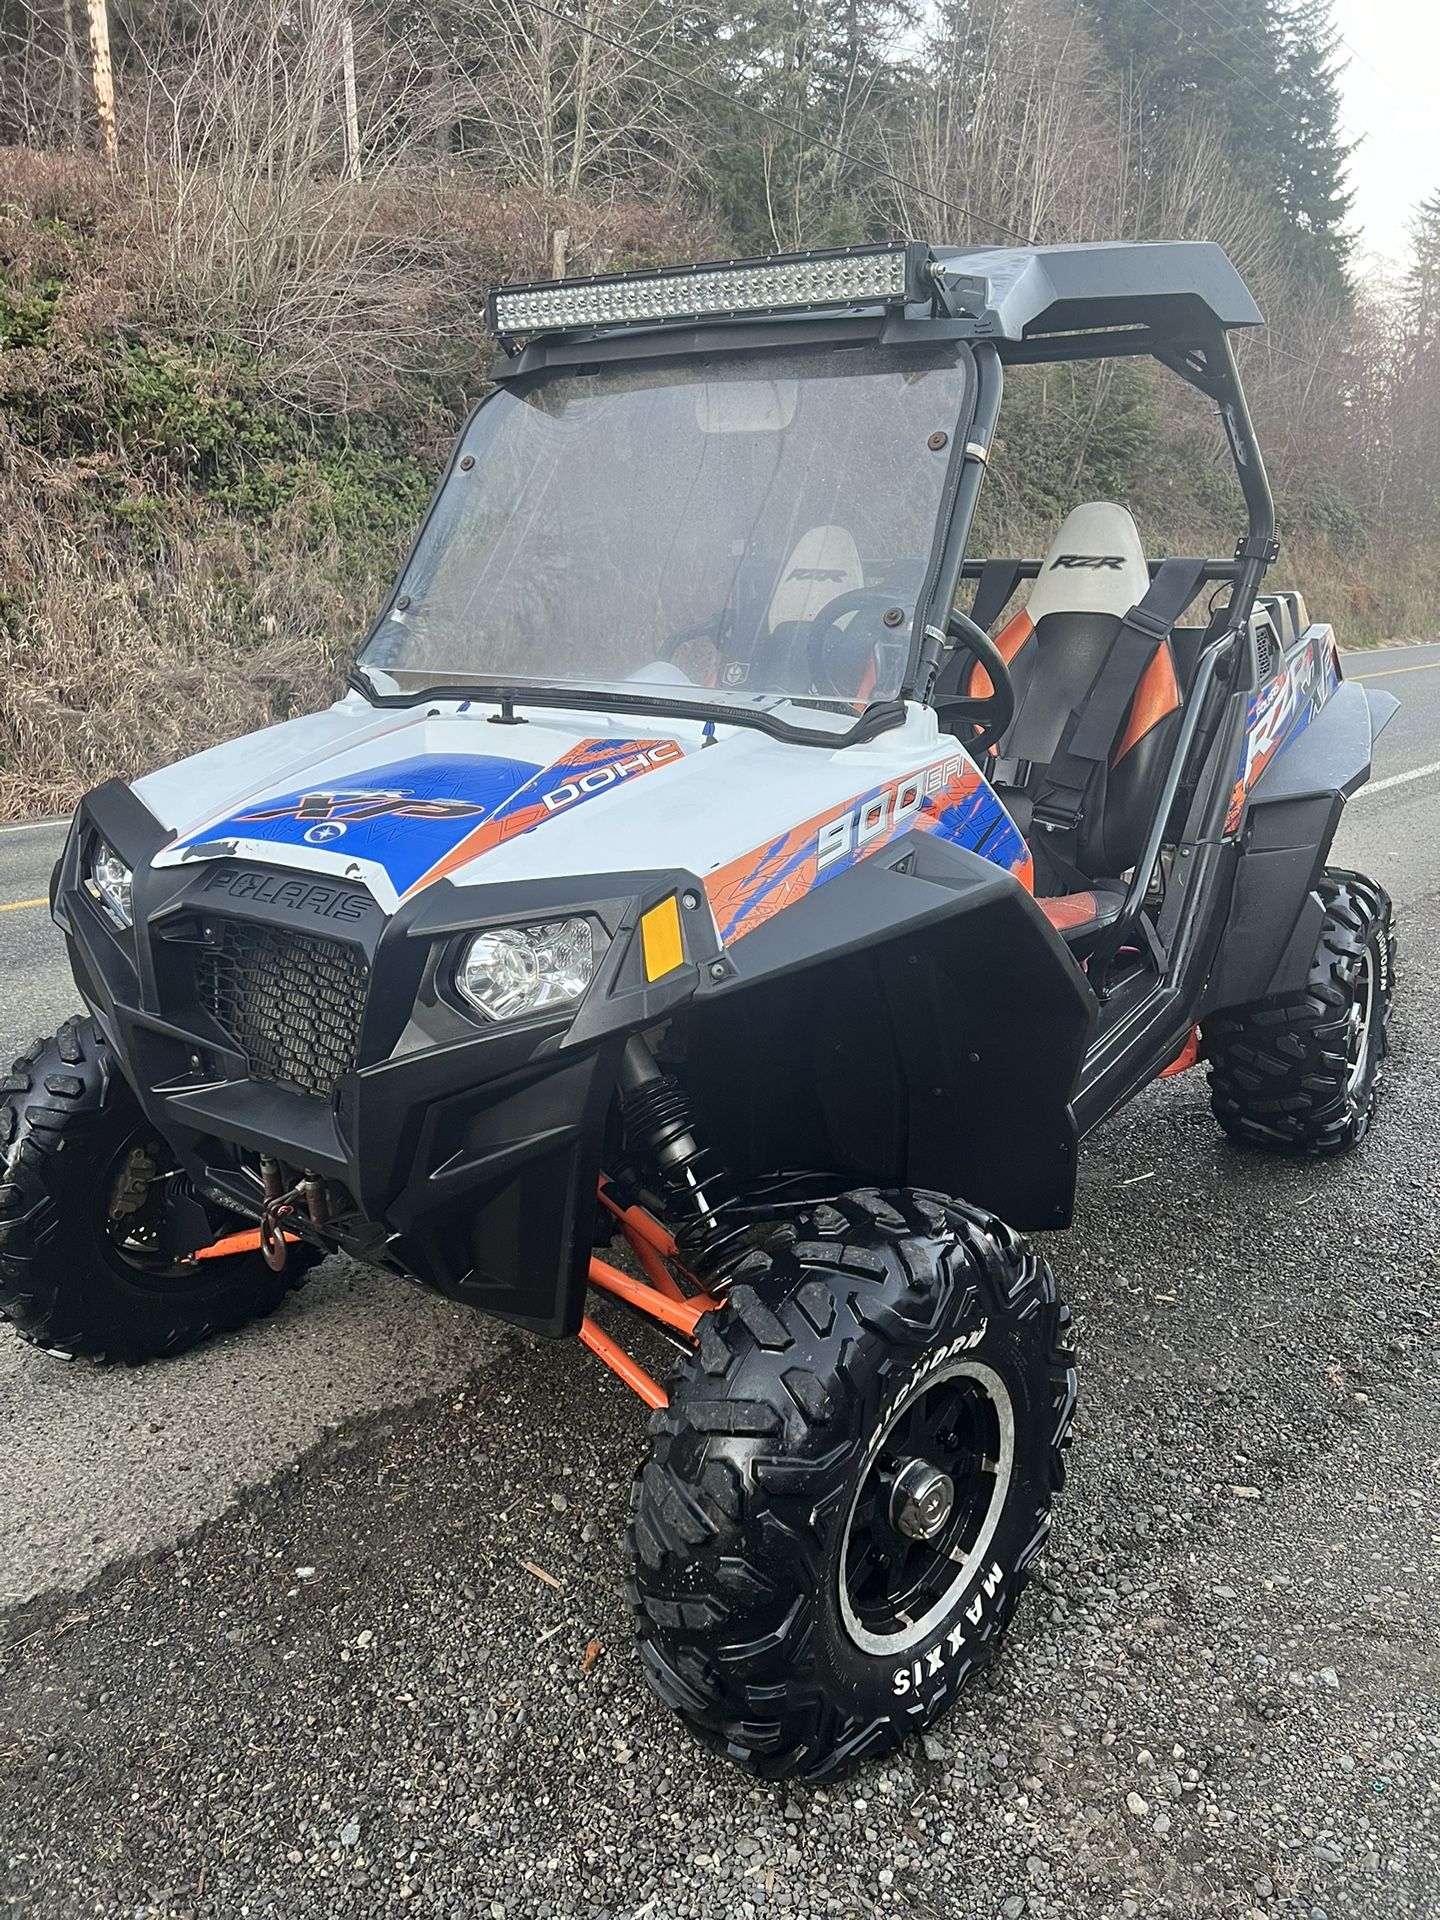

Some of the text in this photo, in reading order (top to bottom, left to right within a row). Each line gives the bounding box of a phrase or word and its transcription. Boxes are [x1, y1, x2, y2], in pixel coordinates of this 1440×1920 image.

[785, 568, 848, 584] RZR
[1050, 554, 1127, 572] RZR
[541, 743, 679, 812] DOHC
[816, 754, 965, 871] 900 EFI
[203, 868, 374, 923] POLARIS
[1375, 930, 1388, 991] BIGHORN
[892, 1560, 1004, 1696] MAXXIS
